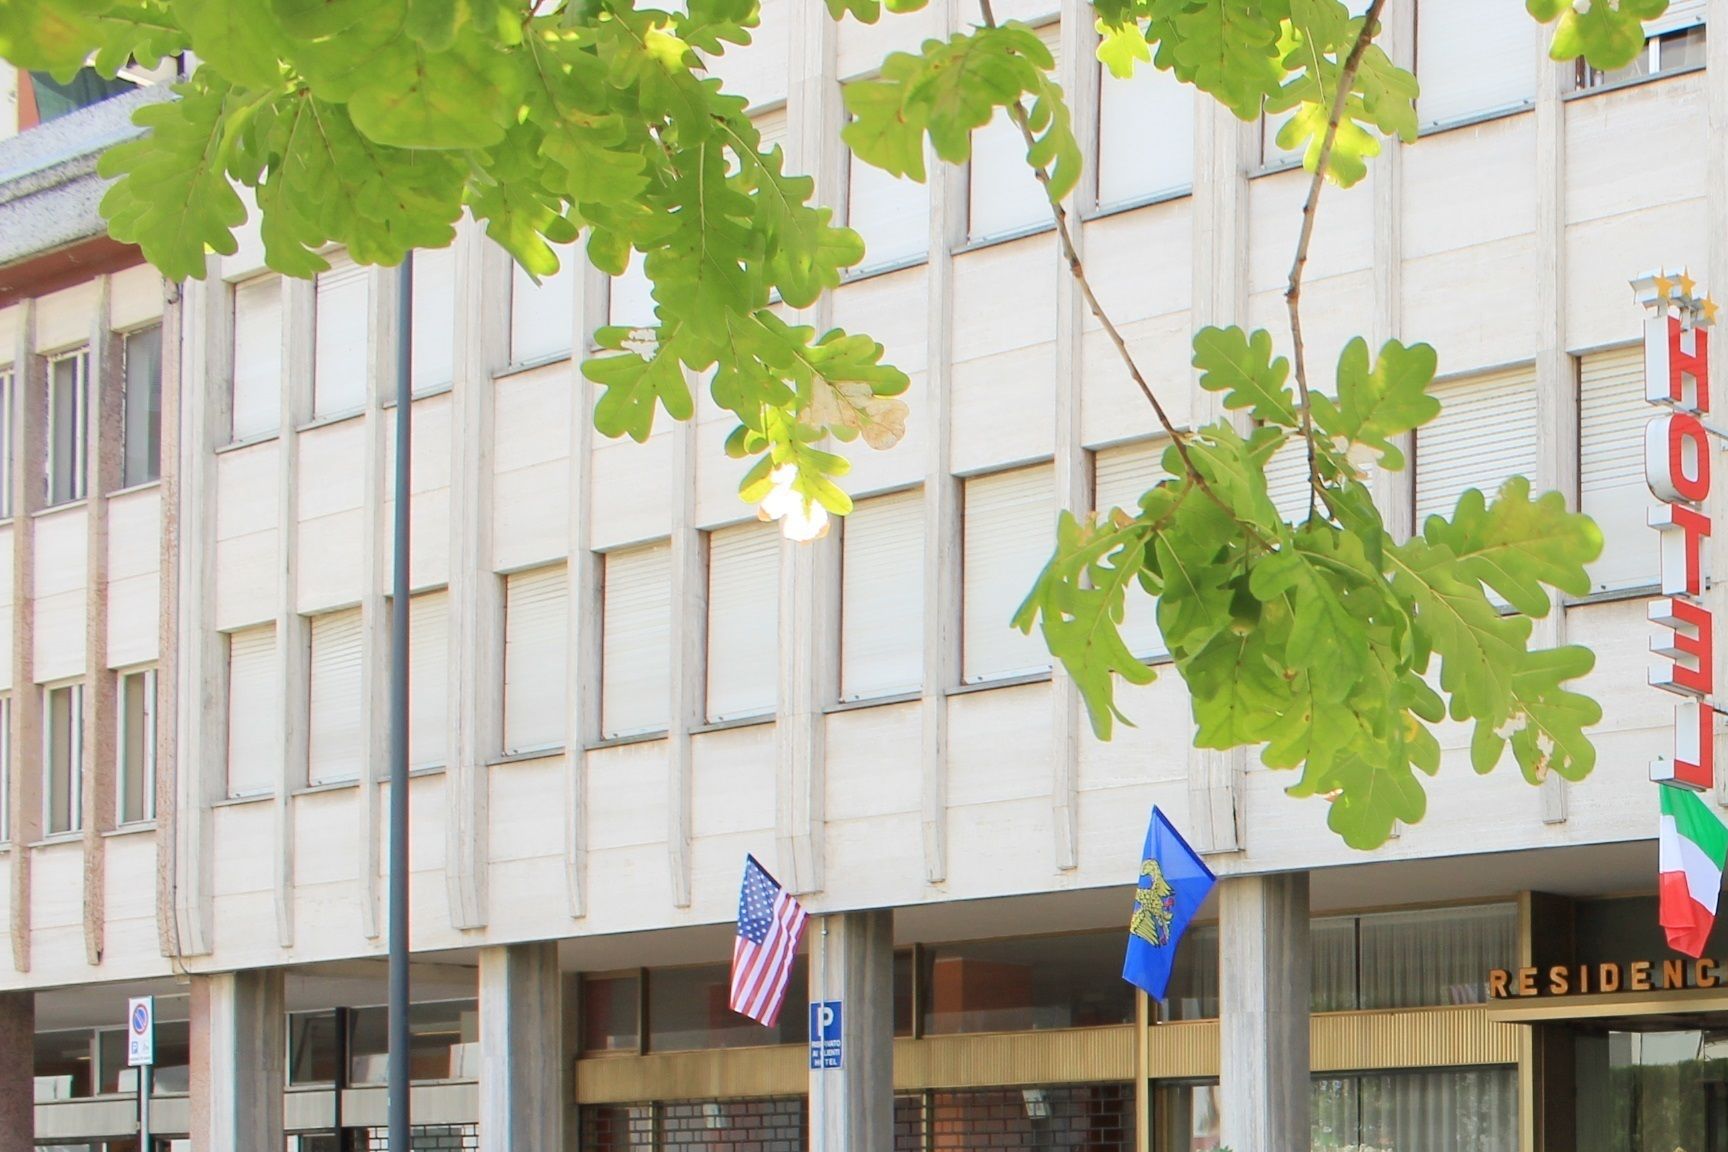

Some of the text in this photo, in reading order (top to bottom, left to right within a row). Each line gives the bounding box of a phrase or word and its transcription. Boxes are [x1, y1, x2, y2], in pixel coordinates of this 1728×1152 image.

[817, 1006, 834, 1036] P
[811, 1040, 841, 1048] RISRVATO
[814, 1058, 838, 1066] HTEL
